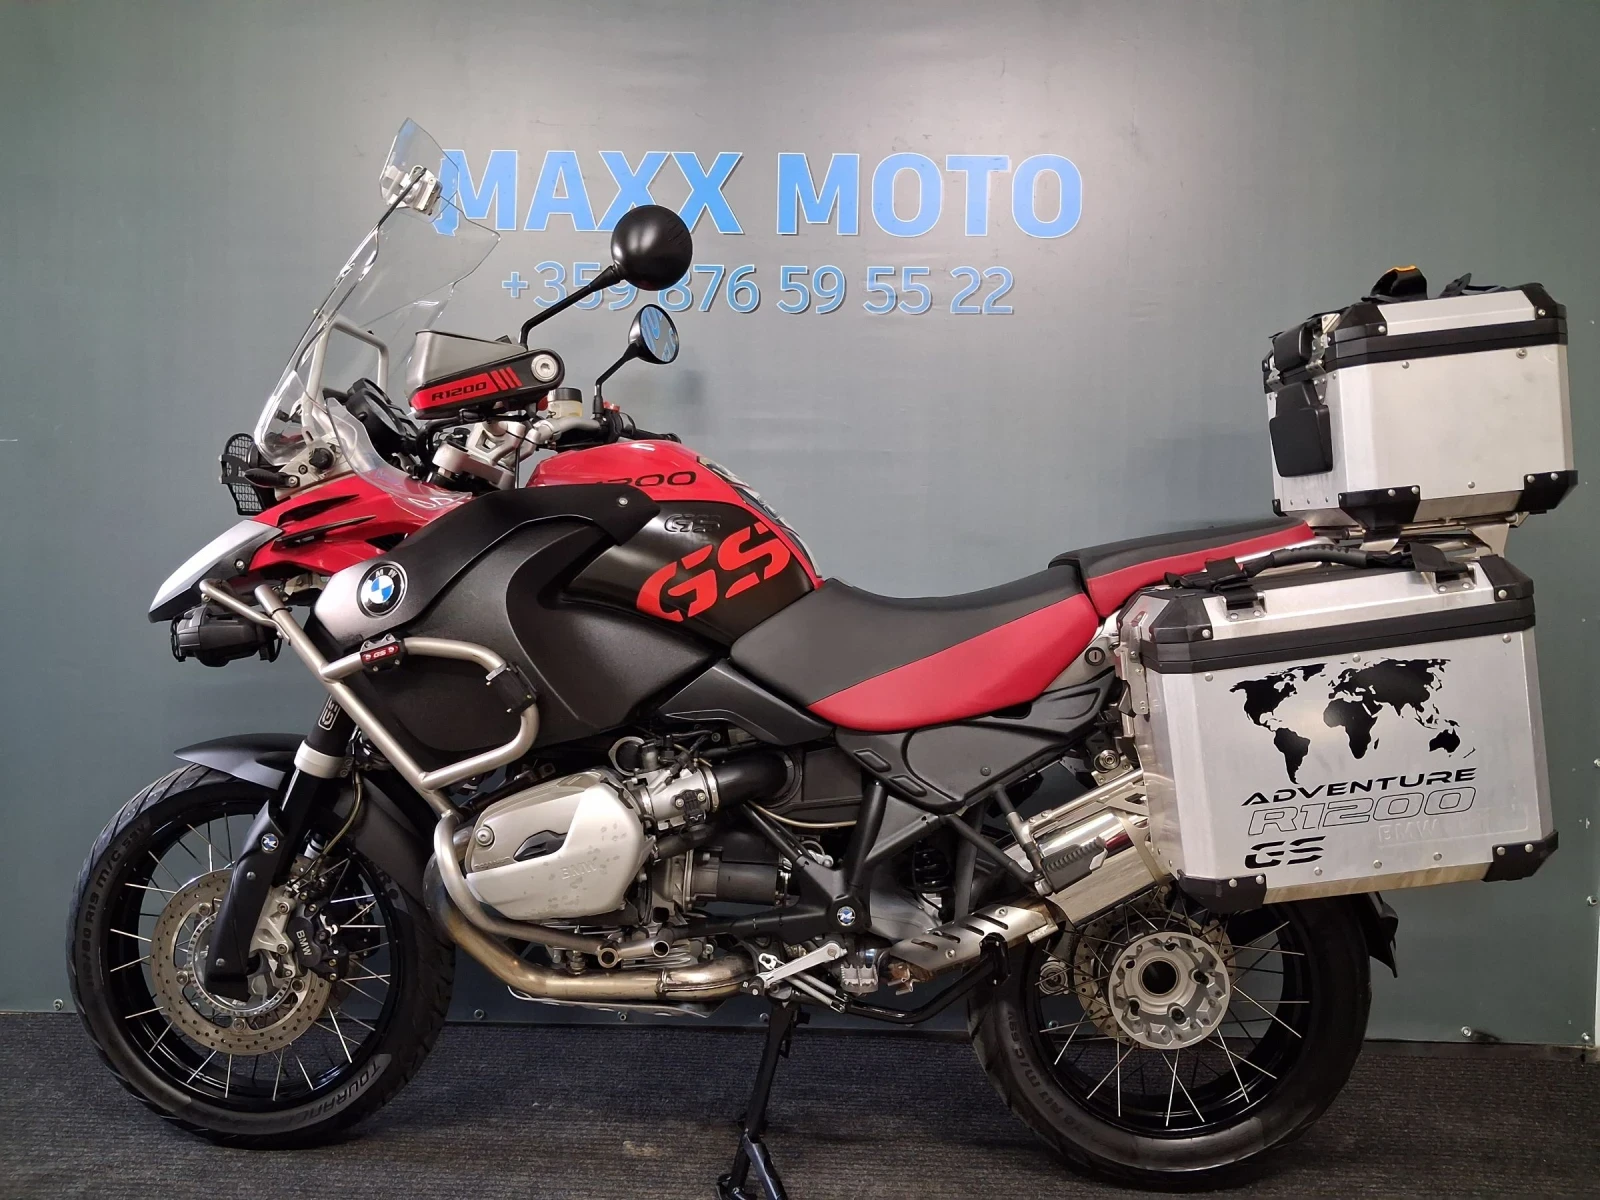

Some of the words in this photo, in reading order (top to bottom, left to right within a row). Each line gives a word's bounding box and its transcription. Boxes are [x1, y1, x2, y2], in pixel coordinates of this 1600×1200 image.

[433, 149, 744, 235] MAXX
[776, 152, 1082, 238] MOTO
[656, 264, 761, 313] 876
[776, 265, 846, 314] 59
[863, 266, 932, 314] 55
[950, 266, 1014, 314] 22
[431, 381, 487, 402] R1200
[636, 521, 791, 622] GS
[1241, 768, 1477, 806] ADVENTURE
[1248, 786, 1477, 836] R1200
[1245, 836, 1327, 869] GS
[296, 930, 312, 956] BMW
